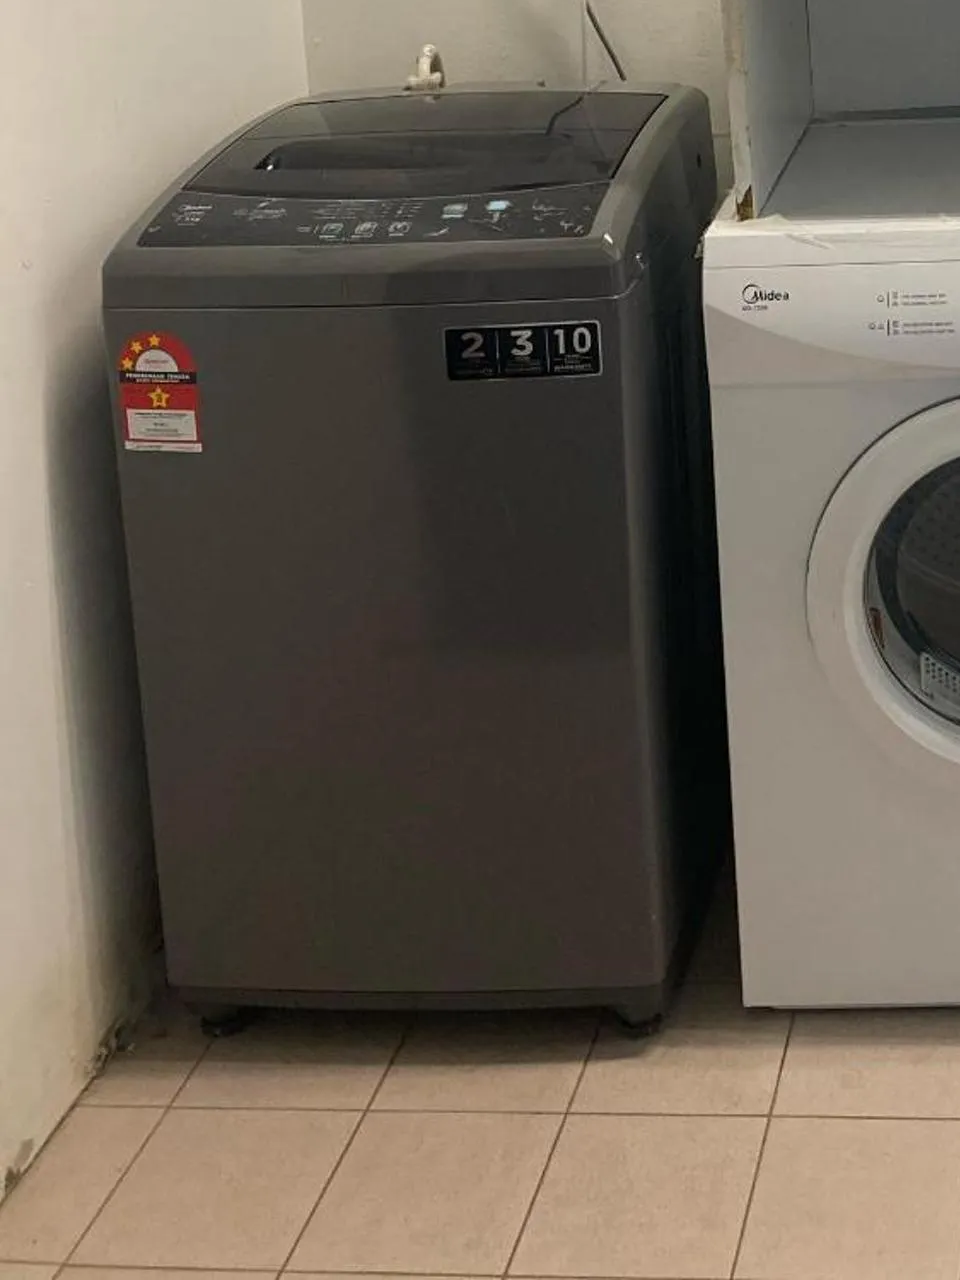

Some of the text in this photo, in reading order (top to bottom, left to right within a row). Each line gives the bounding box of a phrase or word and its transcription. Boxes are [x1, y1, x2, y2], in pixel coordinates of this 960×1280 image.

[744, 287, 789, 302] Midea
[461, 326, 592, 359] 2 3 10
